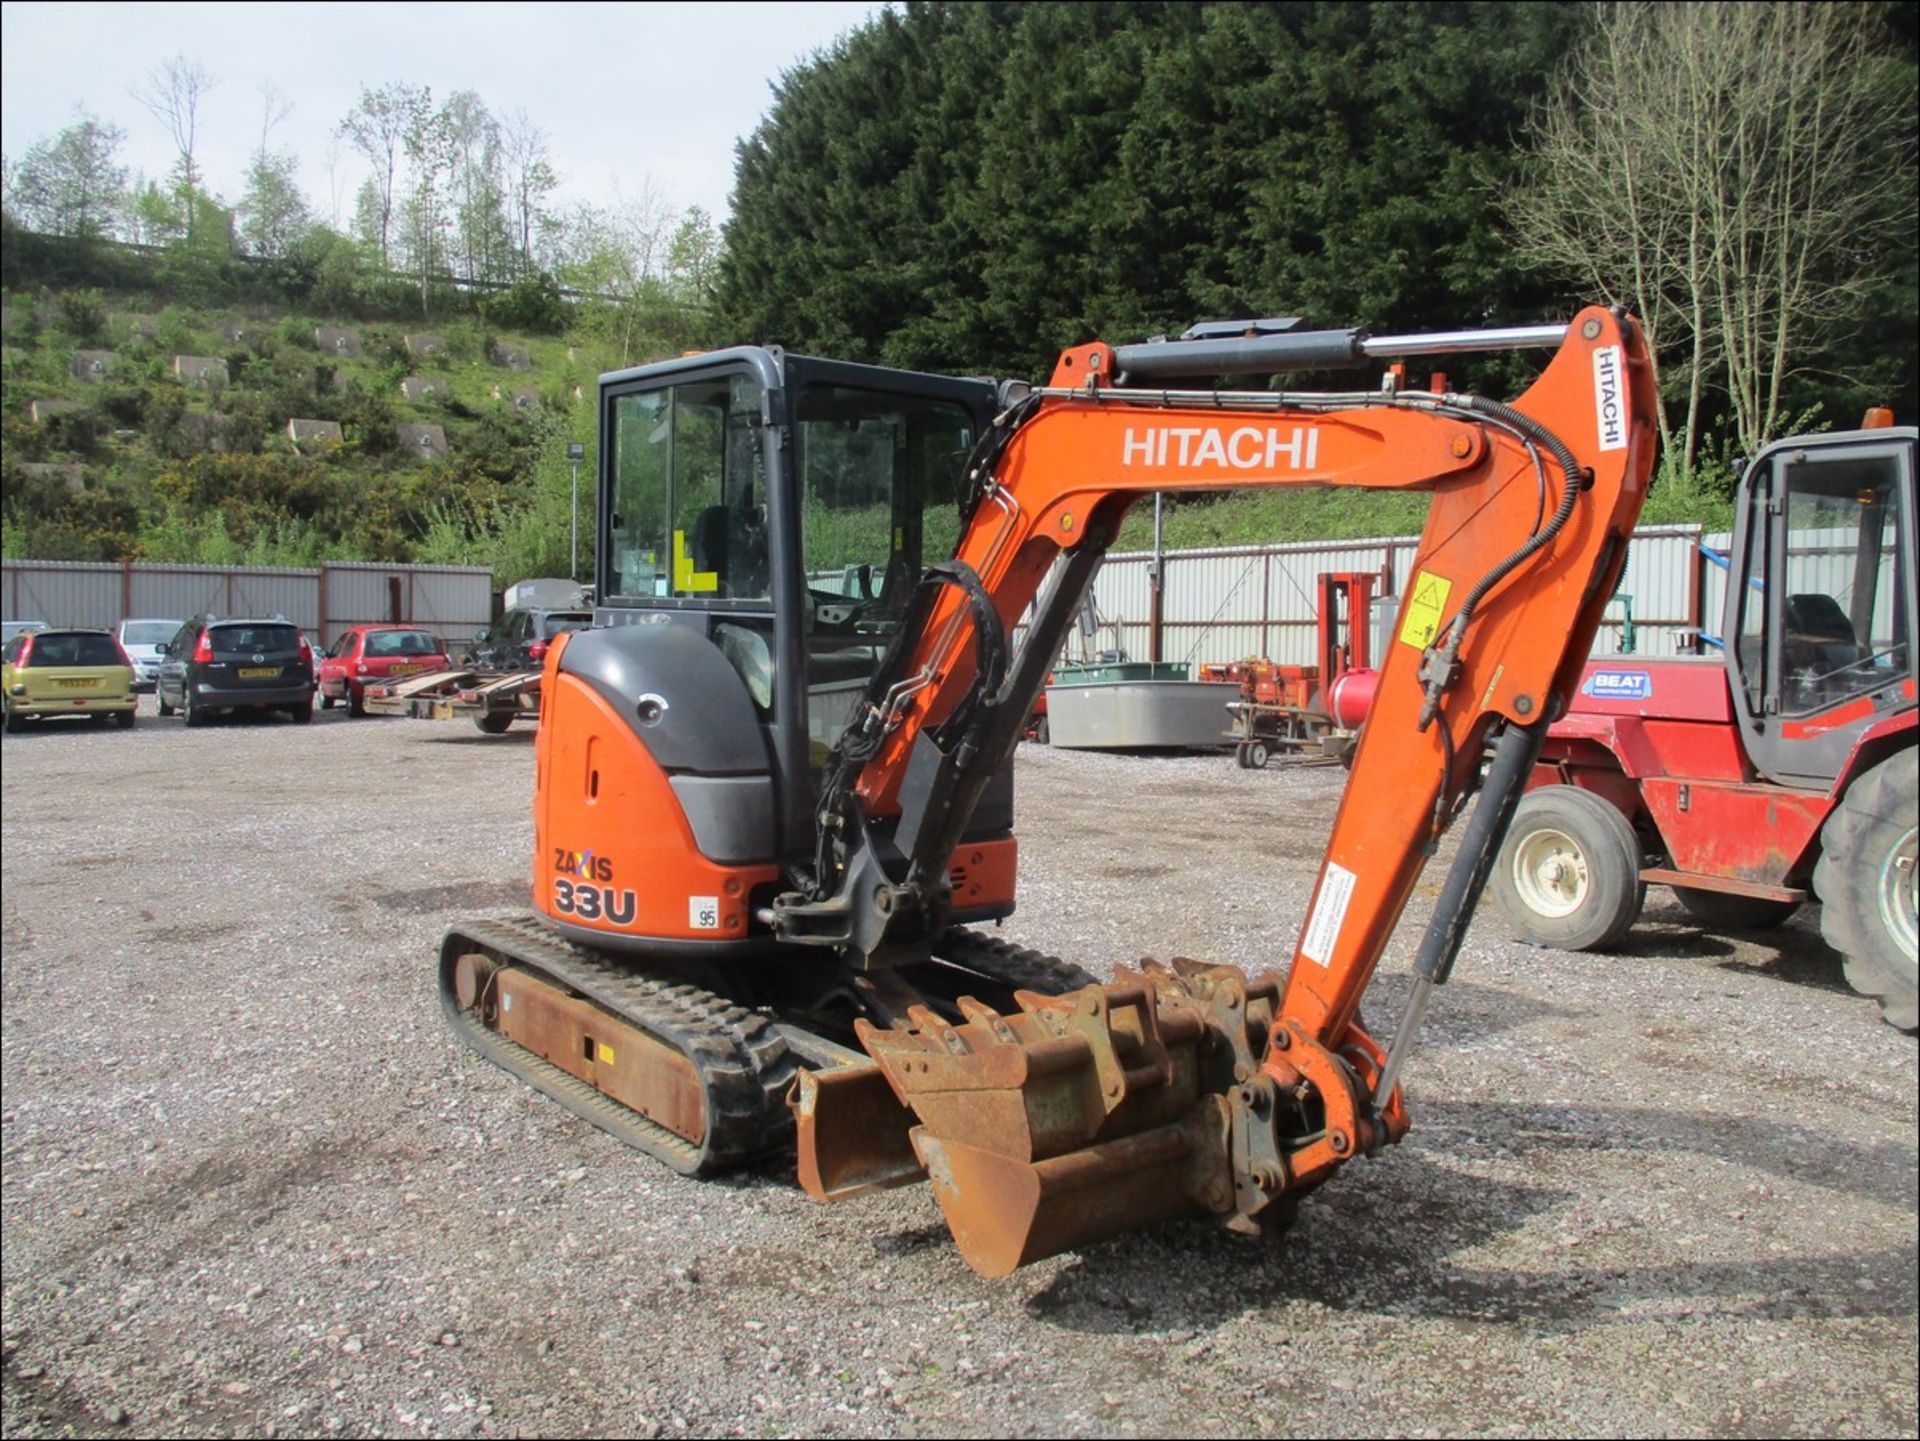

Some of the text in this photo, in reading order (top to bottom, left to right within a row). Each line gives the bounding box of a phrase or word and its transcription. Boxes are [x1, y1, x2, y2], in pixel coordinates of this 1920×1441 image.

[1599, 351, 1620, 444] HITACHI
[1122, 427, 1319, 469] HITACHI
[1595, 674, 1645, 688] BEAT
[554, 848, 613, 882] ZAXIS
[554, 877, 637, 926] 33U
[699, 910, 716, 926] 95
